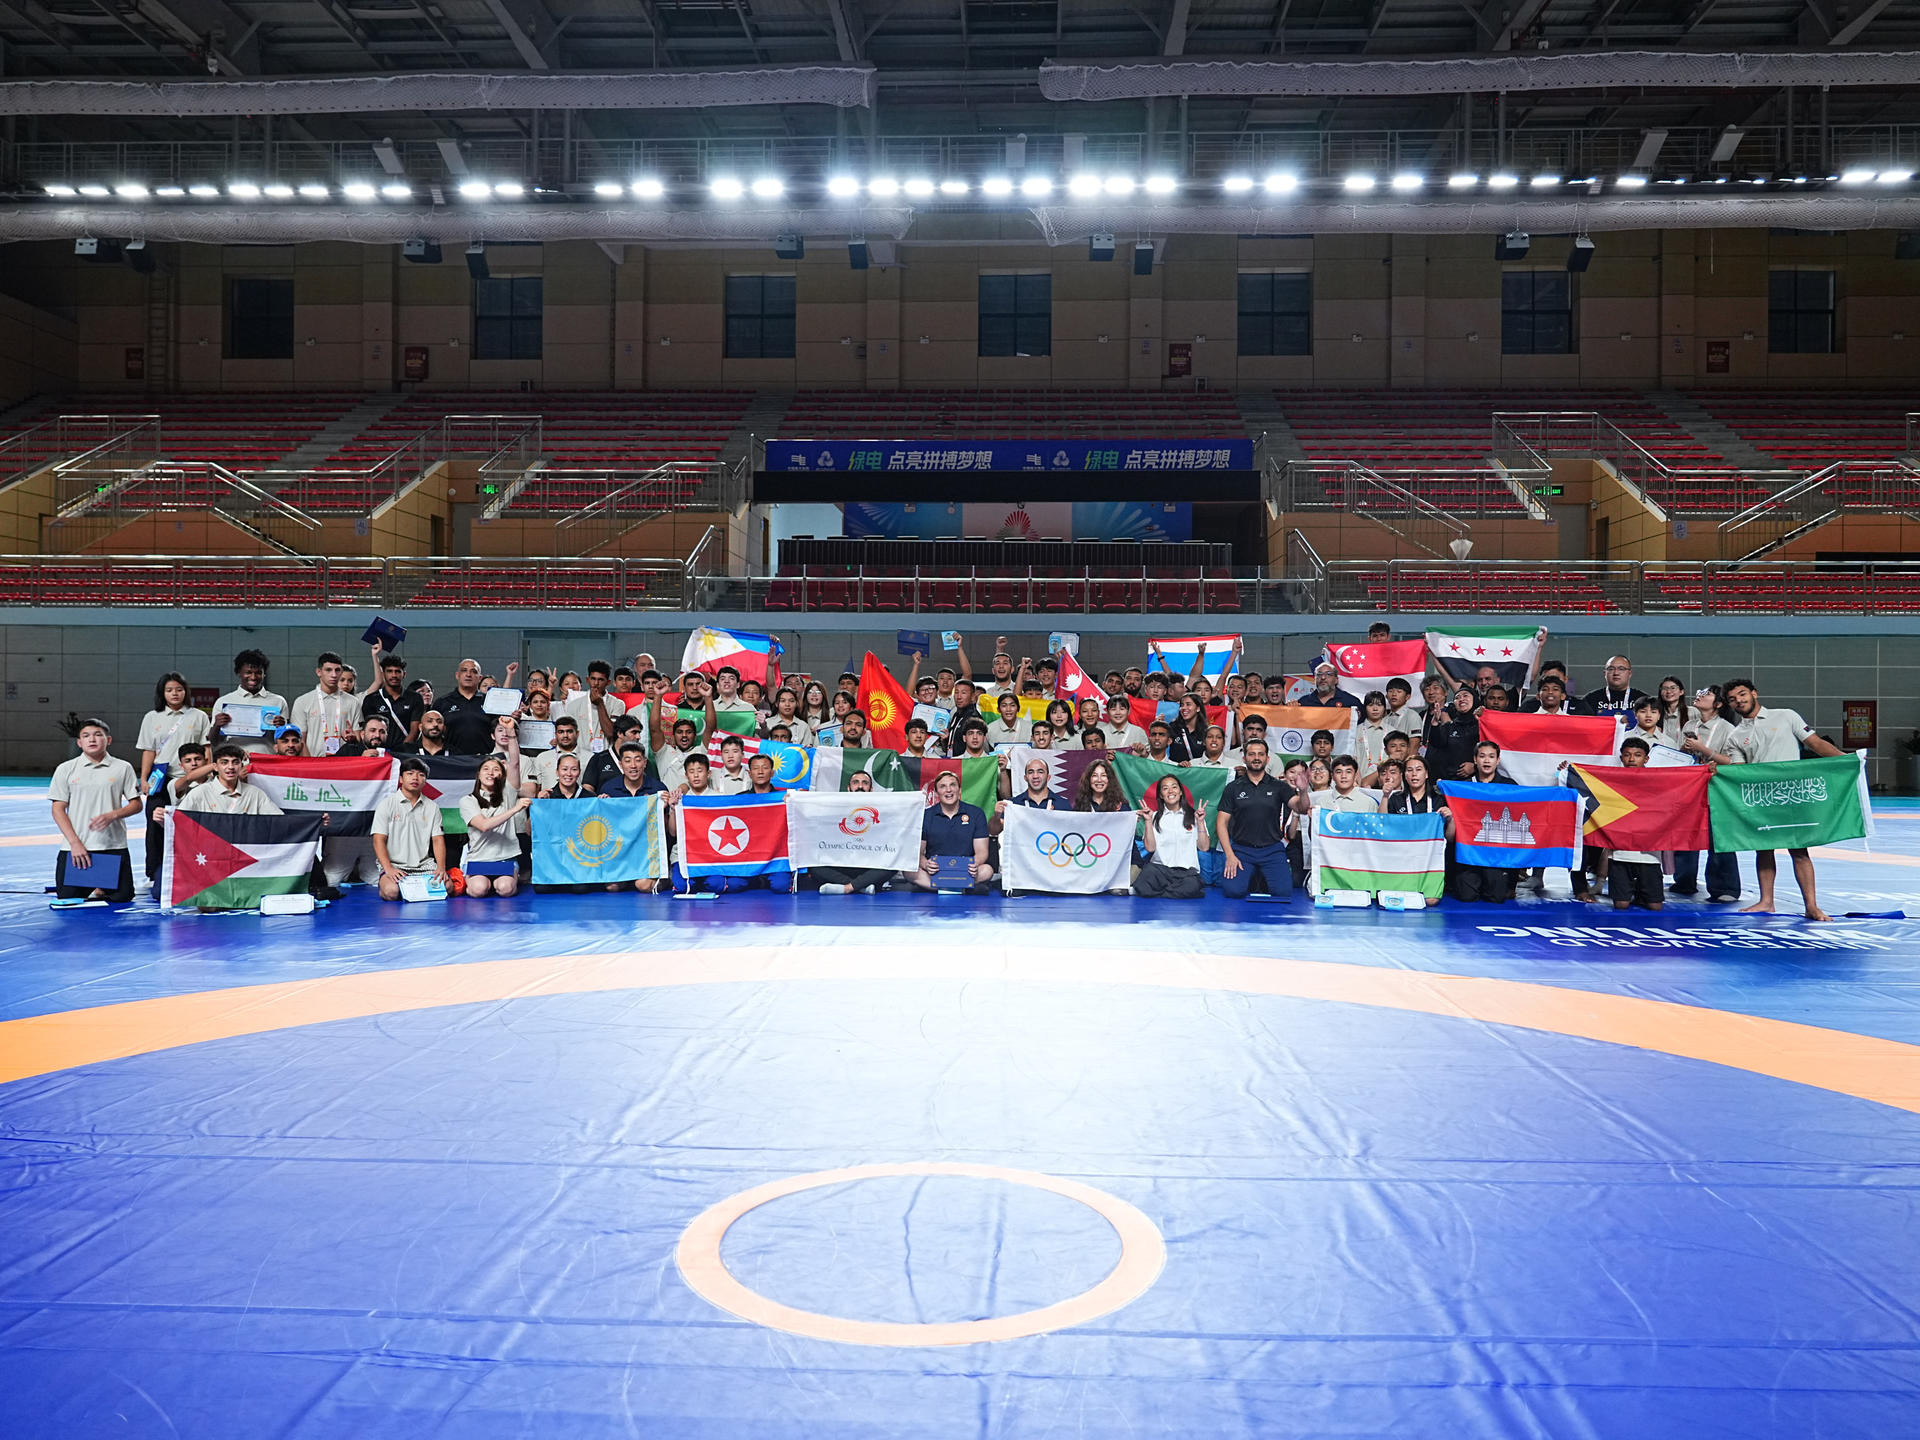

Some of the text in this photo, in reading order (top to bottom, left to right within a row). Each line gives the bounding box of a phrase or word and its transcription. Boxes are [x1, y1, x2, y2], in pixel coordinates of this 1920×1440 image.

[848, 450, 993, 471] 绿电 点亮拼搏梦想
[1084, 449, 1231, 470] 绿电 点亮拼搏梦想
[1475, 924, 1899, 942] WRESTLING
[1549, 937, 1891, 951] UNITED WORLD
